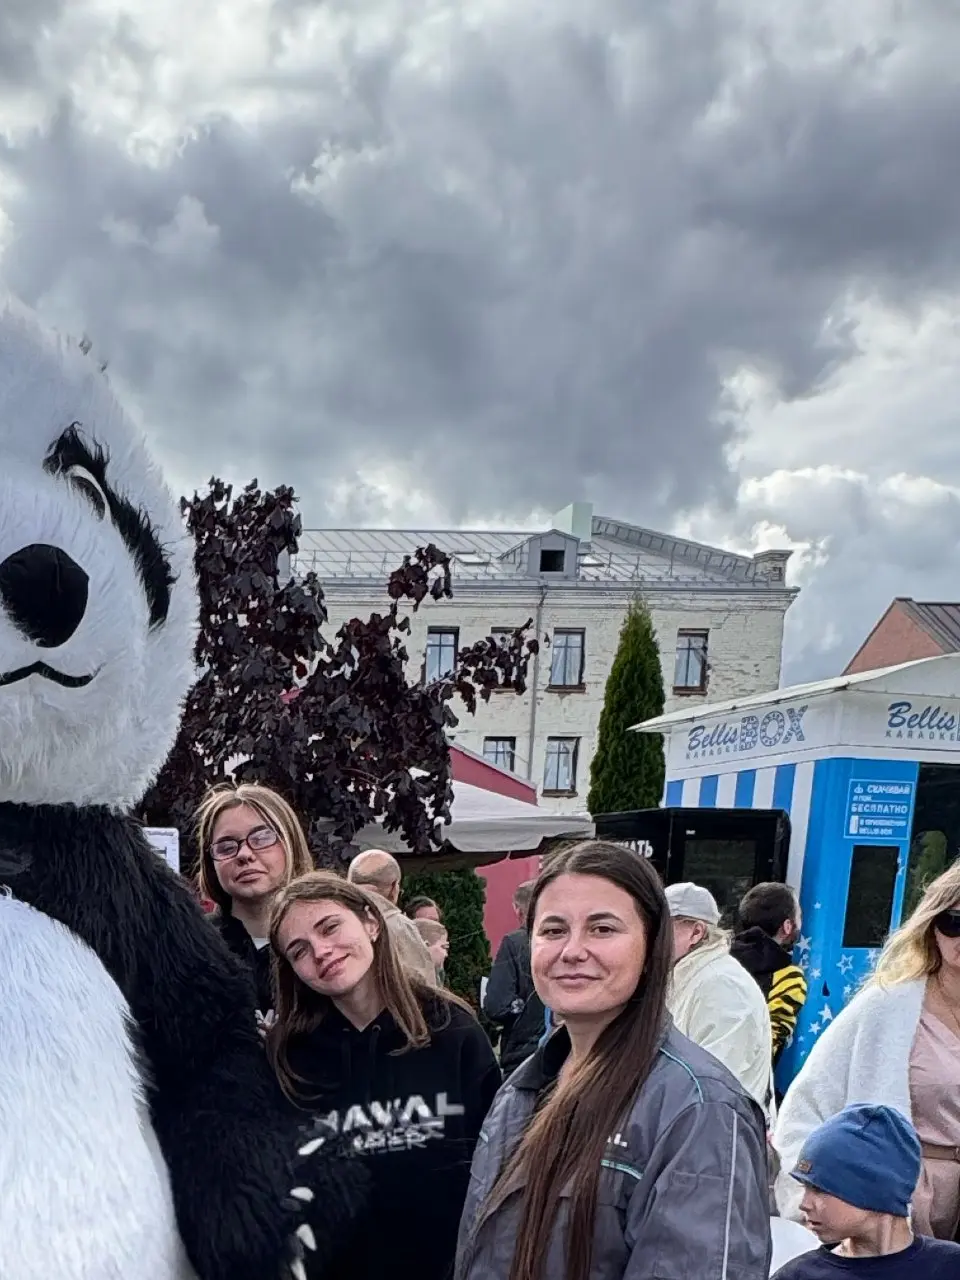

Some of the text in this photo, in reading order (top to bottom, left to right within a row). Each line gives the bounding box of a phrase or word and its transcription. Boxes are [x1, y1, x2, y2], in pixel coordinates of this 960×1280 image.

[887, 702, 957, 731] Bellis
[884, 730, 956, 741] KARAOKE
[851, 803, 908, 814] БЕСПЛАТНО
